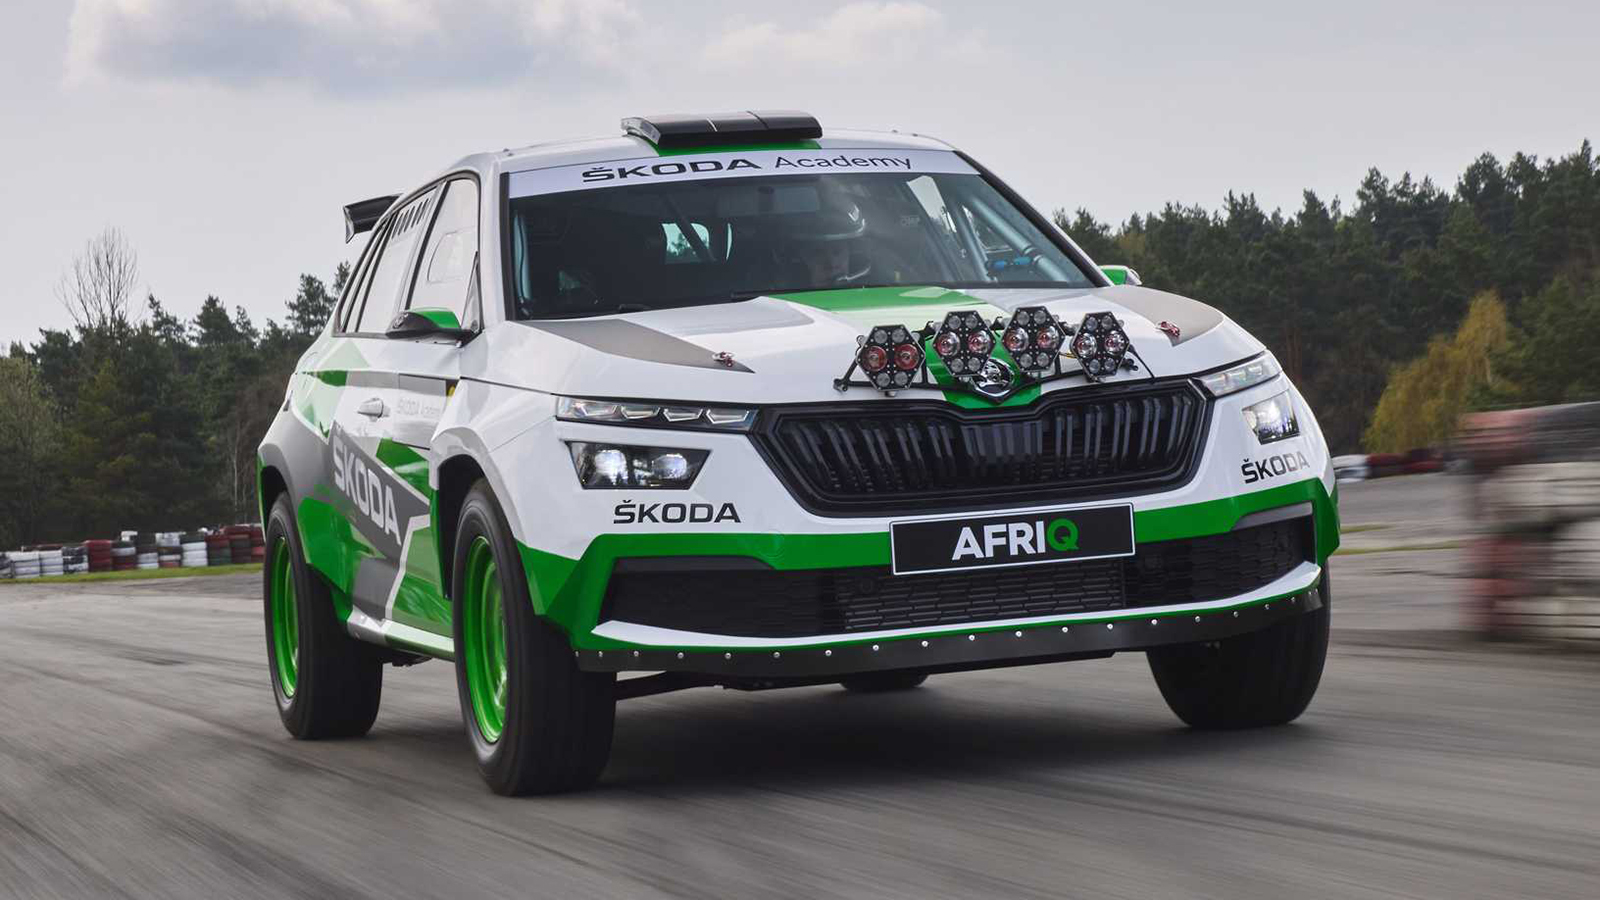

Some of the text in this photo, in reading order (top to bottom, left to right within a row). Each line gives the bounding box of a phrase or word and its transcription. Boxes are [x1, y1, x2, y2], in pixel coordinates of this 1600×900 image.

[582, 155, 912, 183] ŠKODA Academy
[1241, 451, 1311, 485] ŠKODA
[613, 499, 742, 524] ŠKODA
[951, 518, 1080, 561] AFRIQ
